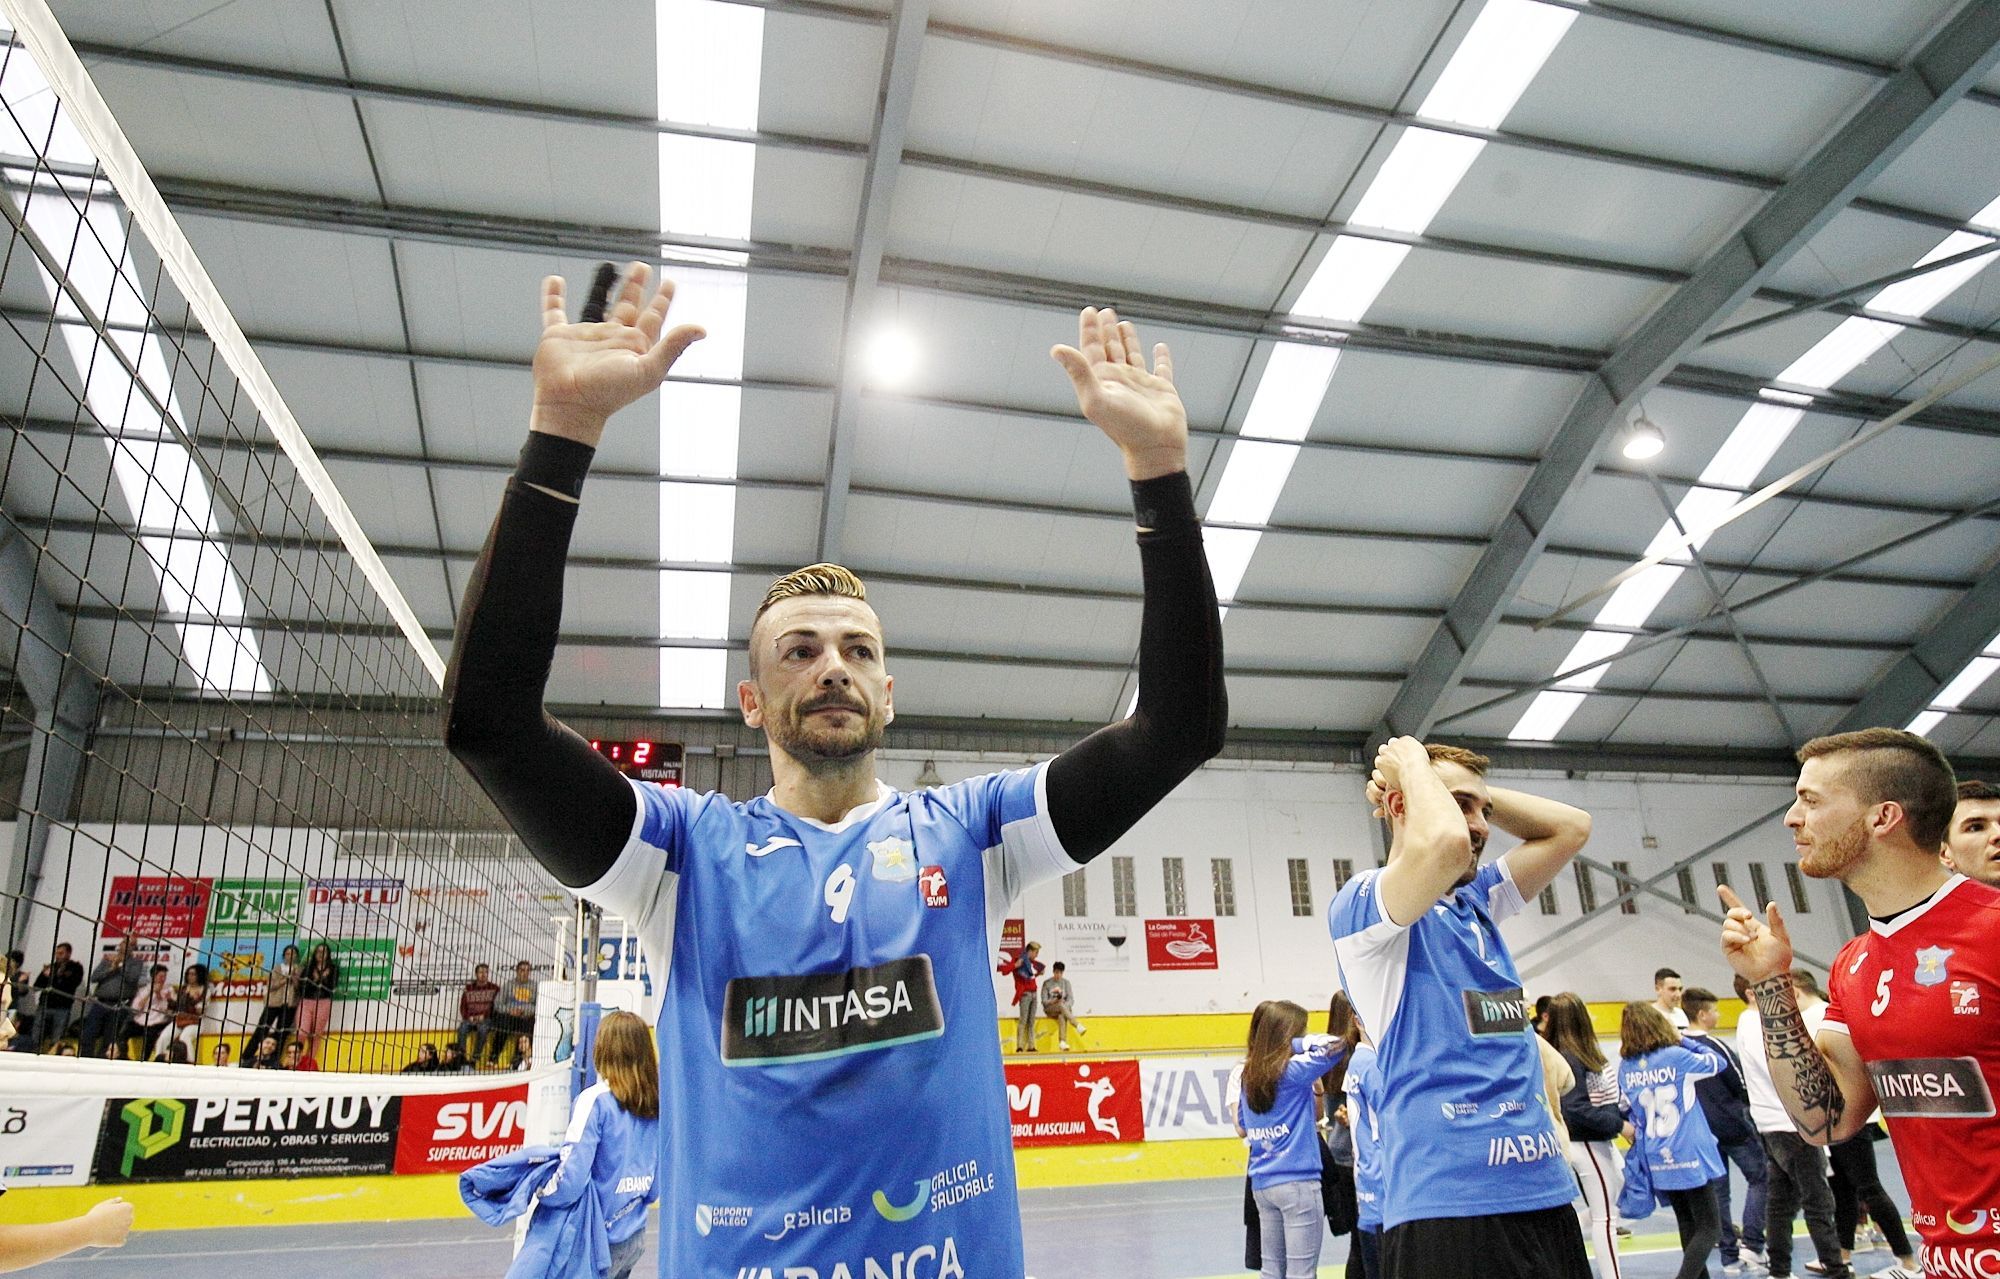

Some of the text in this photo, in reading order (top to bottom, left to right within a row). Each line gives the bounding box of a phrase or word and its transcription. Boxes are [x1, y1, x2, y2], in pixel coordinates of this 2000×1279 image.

[633, 743, 650, 763] 2
[641, 769, 676, 779] VISITANTE
[824, 863, 856, 924] 9
[926, 896, 948, 906] SVM
[1058, 923, 1106, 931] BAR XAYDA
[207, 981, 269, 997] Moech
[1871, 968, 1894, 1016] 5
[783, 980, 913, 1033] INTASA
[1953, 1006, 1980, 1015] SVM
[1625, 1066, 1676, 1090] BARANOV
[1882, 1072, 1966, 1097] INTASA
[192, 1095, 393, 1133] PERMUY
[1638, 1083, 1681, 1140] 15
[1035, 1121, 1086, 1136] MASCULINA
[189, 1132, 390, 1149] ELECTRICIDAD OBRAS Y SERVICIOS
[427, 1145, 487, 1162] SUPERLIGA
[616, 1175, 653, 1194] ABANC
[931, 1159, 977, 1192] GALICIA
[931, 1173, 995, 1213] SAUDABLE
[713, 1206, 752, 1217] DEPORTE
[713, 1216, 748, 1227] GALEGO
[764, 1206, 852, 1240] galicia
